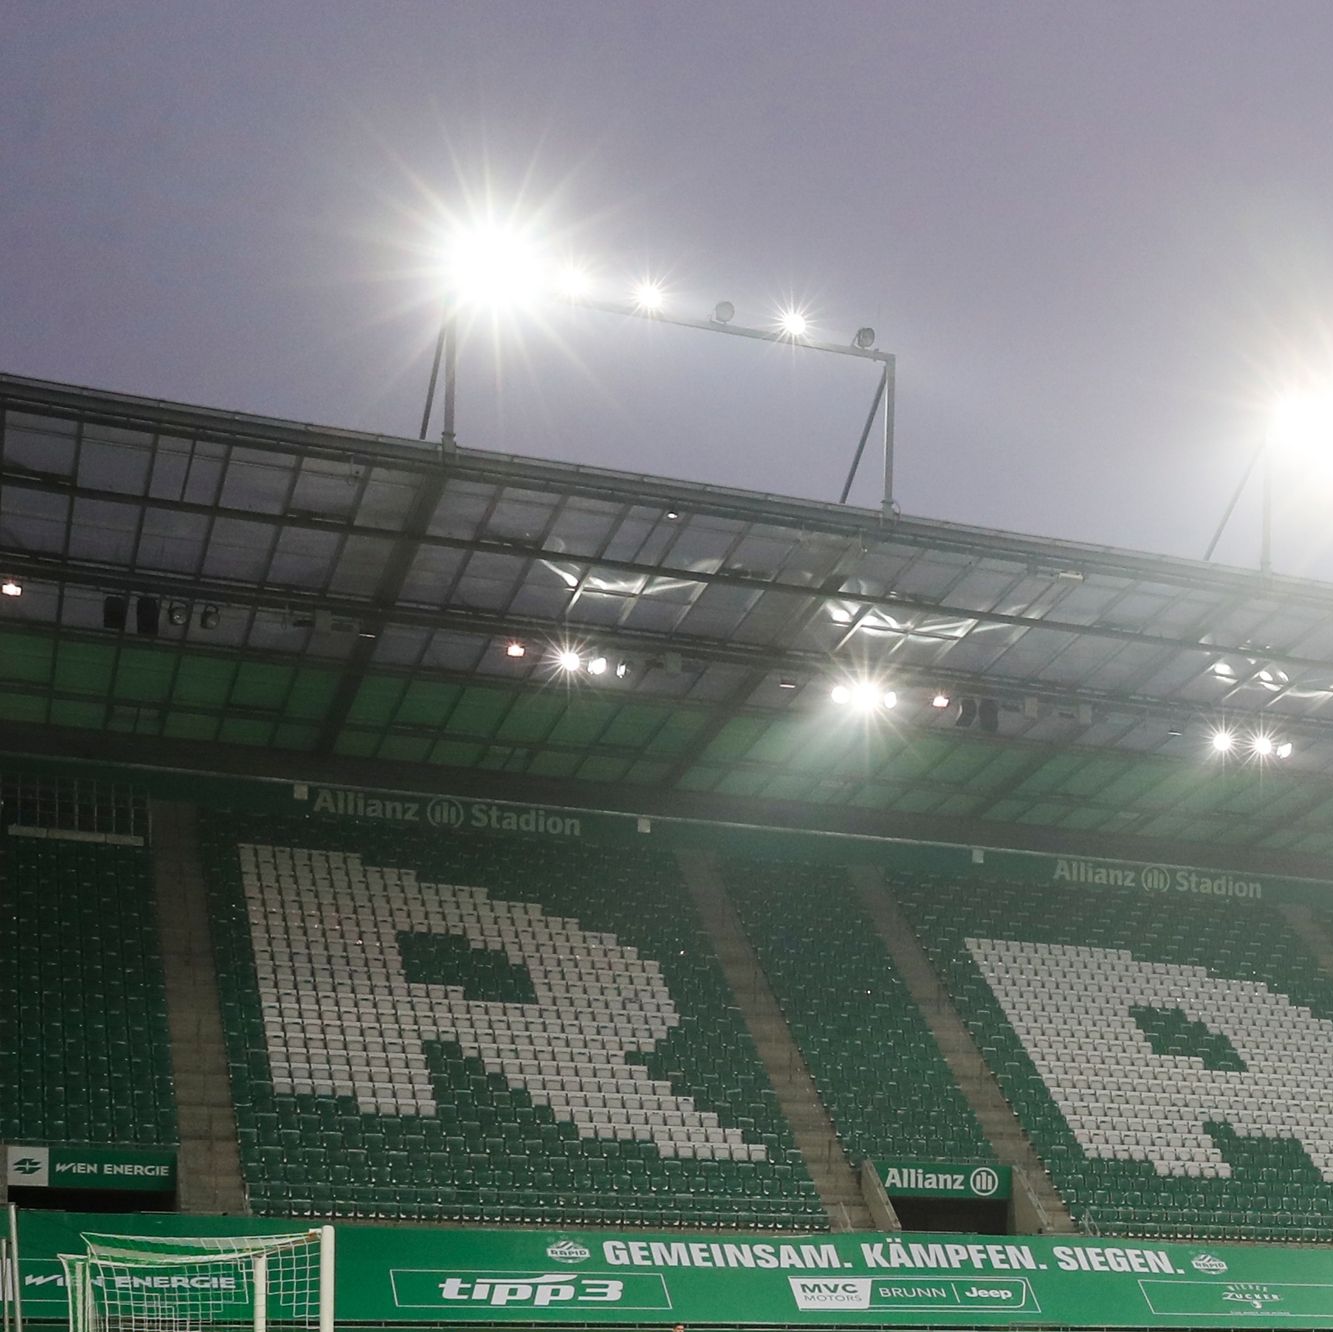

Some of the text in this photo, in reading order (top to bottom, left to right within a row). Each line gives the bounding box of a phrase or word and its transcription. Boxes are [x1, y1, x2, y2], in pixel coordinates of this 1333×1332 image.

[313, 788, 582, 836] Allianz Stadion
[1054, 859, 1262, 899] Allianz Stadion
[55, 1162, 170, 1177] WIEN ENERGIE
[883, 1167, 965, 1192] Allianz
[602, 1237, 1186, 1275] GEMEINSAM. KÄMPFEN. SIEGEN.
[25, 1274, 103, 1288] WIN
[437, 1273, 624, 1306] tipp3
[800, 1282, 1014, 1302] MVC MOTORS BRUNN Jeep
